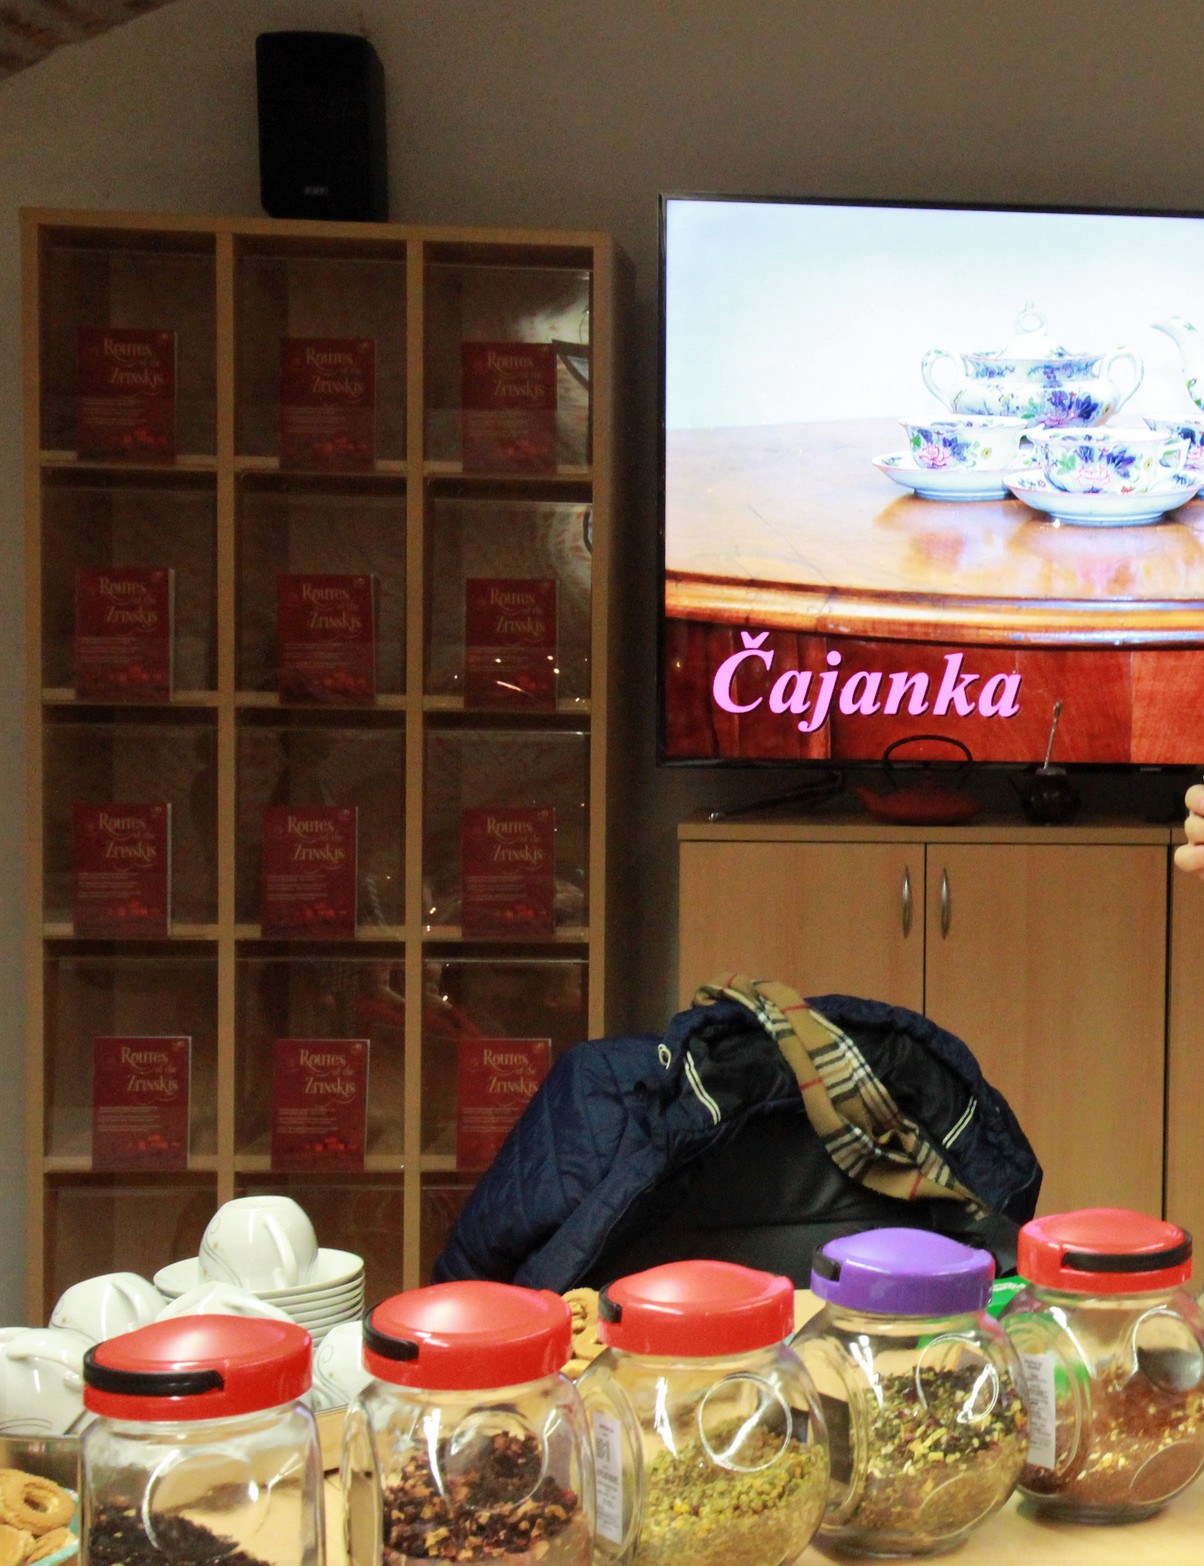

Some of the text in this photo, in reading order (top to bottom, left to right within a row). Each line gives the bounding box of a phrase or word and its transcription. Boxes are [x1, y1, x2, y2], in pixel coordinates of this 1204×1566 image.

[713, 631, 1022, 733] Čajanka
[99, 814, 147, 833] Routes
[288, 816, 334, 835] Routes
[487, 818, 533, 838] Routes
[122, 1047, 169, 1067] Routes
[300, 1049, 345, 1070] Routes
[484, 1049, 528, 1068] Routes
